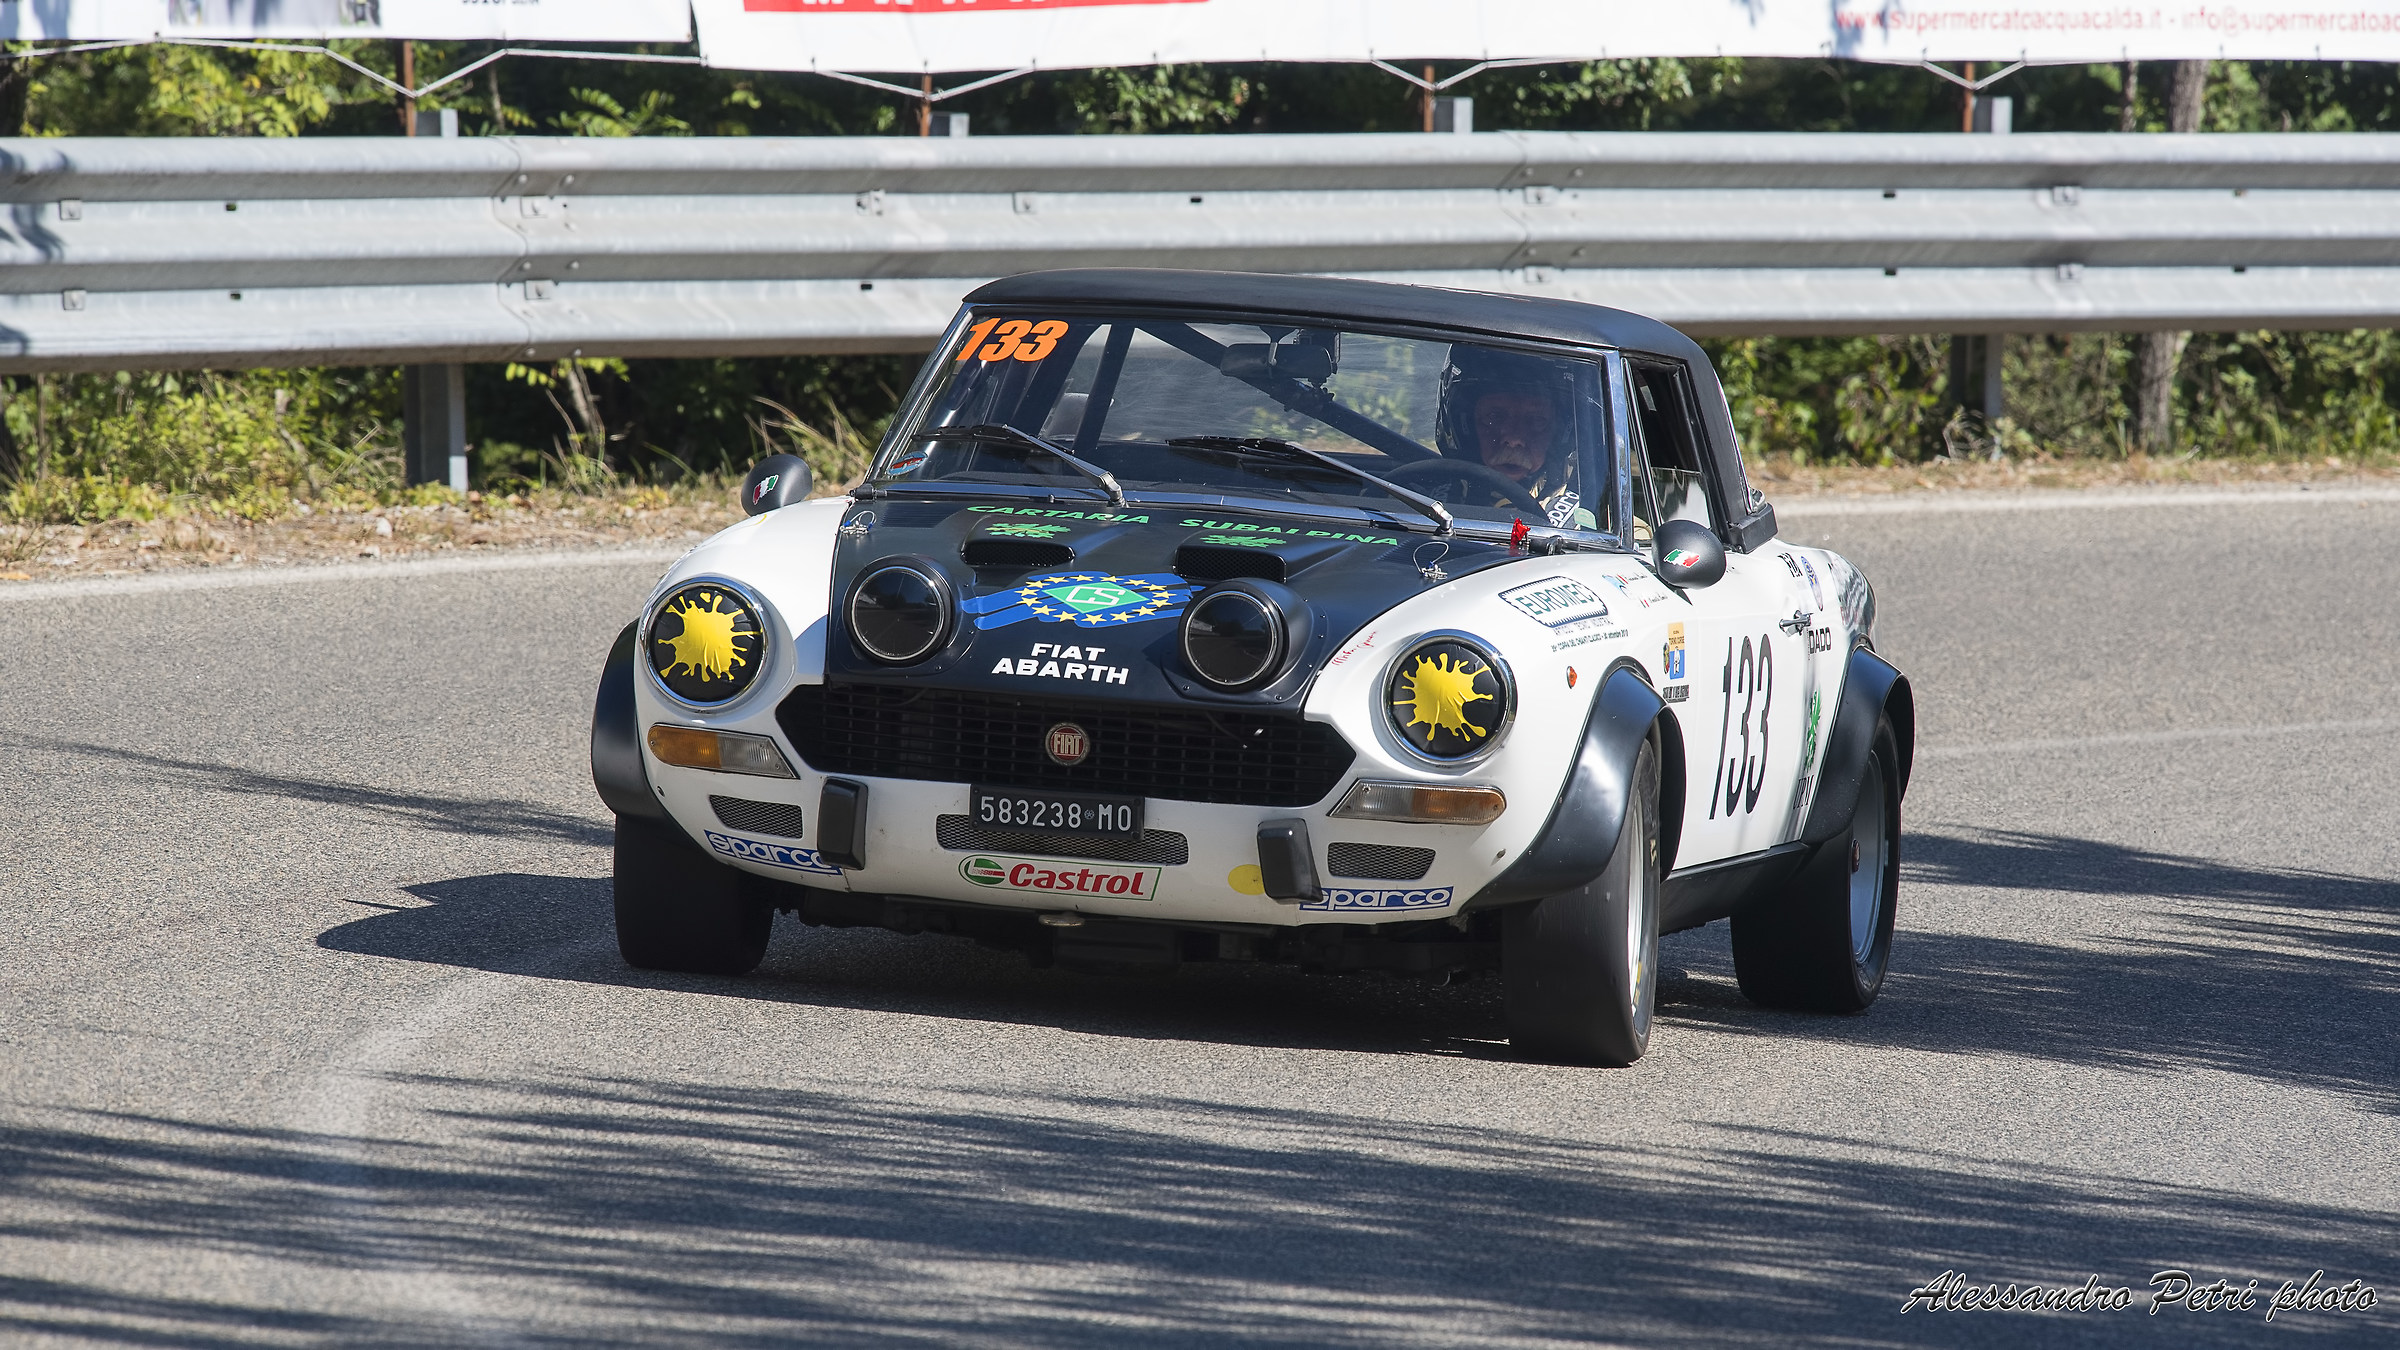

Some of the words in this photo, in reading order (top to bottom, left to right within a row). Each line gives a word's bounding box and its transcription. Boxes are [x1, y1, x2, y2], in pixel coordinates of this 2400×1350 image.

[956, 318, 1069, 362] 133
[967, 505, 1150, 524] CARTARIA
[1515, 582, 1596, 616] EUROMEC
[1031, 642, 1106, 662] FIAT
[1808, 626, 1831, 654] DADO
[991, 657, 1130, 686] ABARTH
[1708, 633, 1773, 820] 133
[1053, 734, 1081, 755] FIAT
[981, 796, 1082, 829] 583238
[1098, 804, 1132, 832] MO
[708, 833, 833, 870] sparco
[1009, 863, 1145, 896] Castrol
